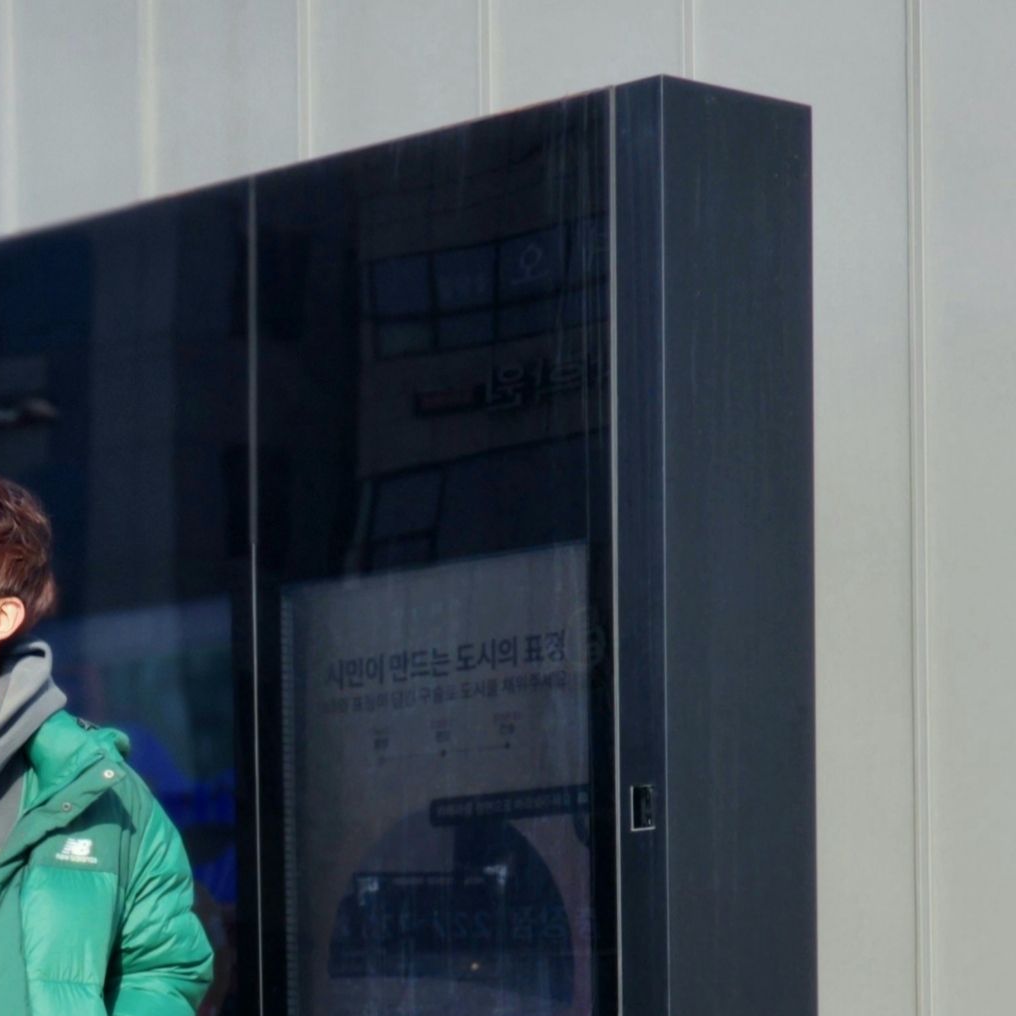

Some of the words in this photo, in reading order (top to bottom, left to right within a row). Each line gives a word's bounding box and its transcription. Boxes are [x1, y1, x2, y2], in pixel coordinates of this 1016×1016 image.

[326, 653, 384, 690] 시민이
[389, 648, 451, 683] 만드는
[456, 636, 517, 672] 도시의
[523, 629, 566, 663] 표정
